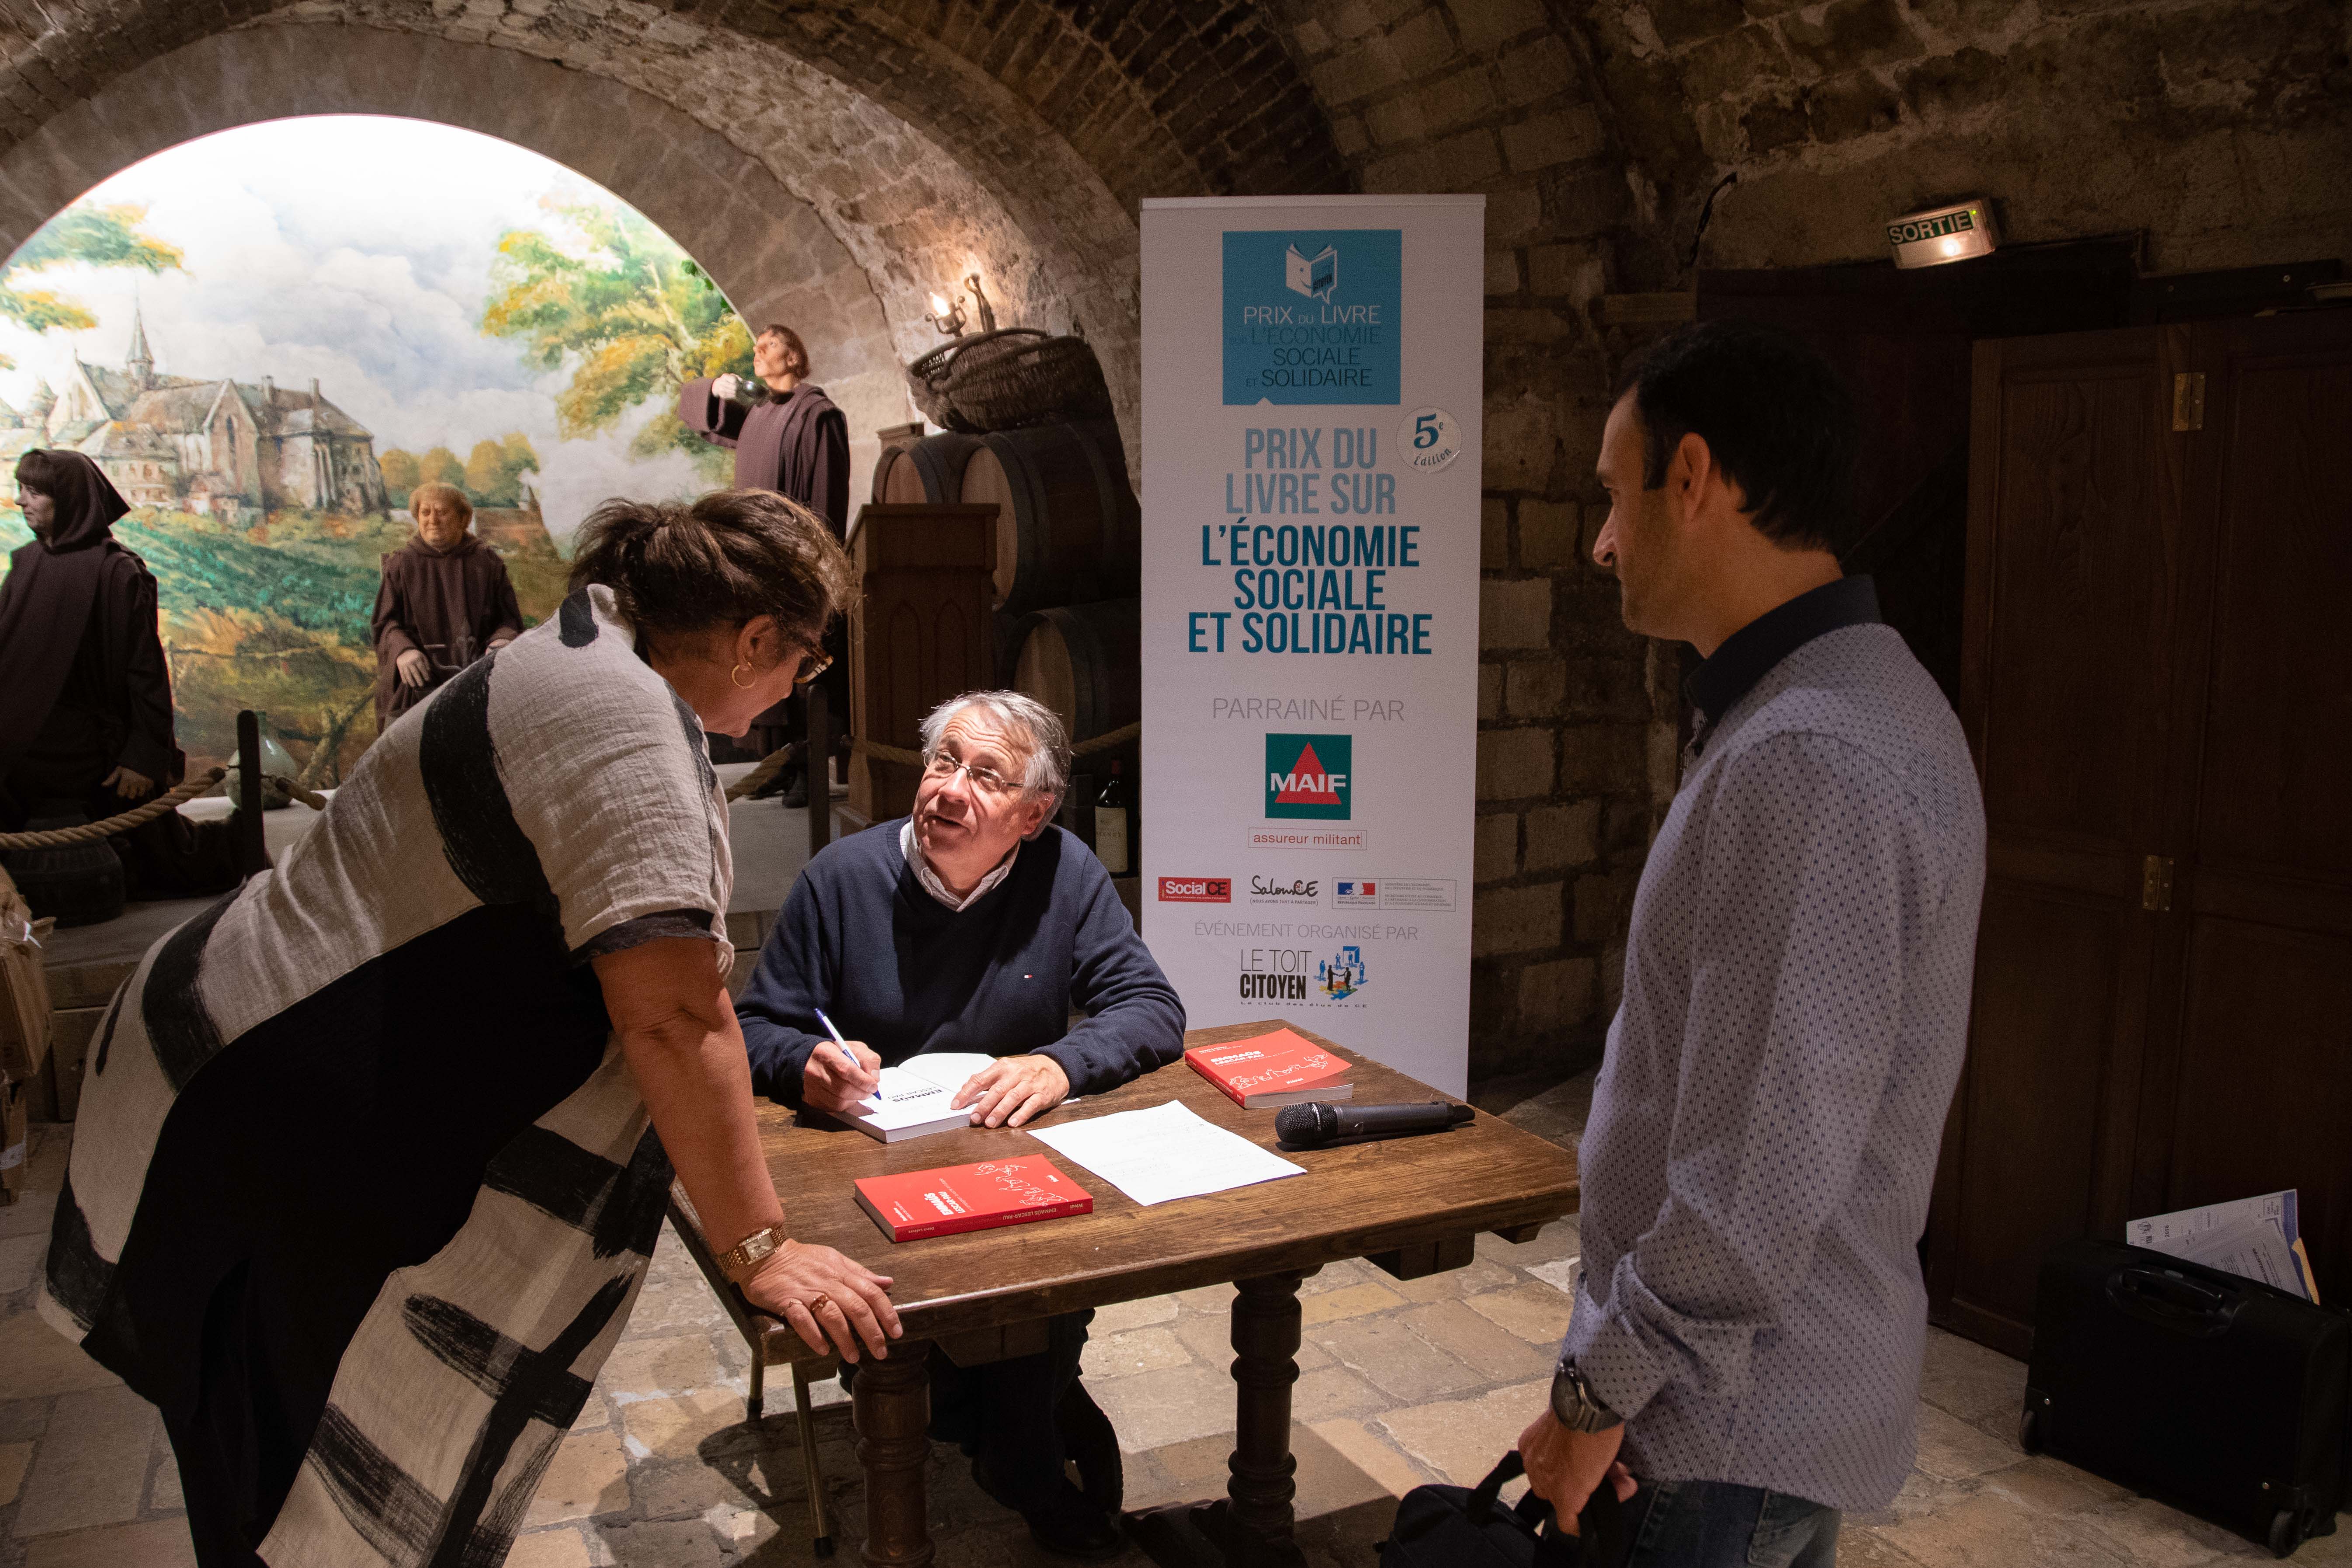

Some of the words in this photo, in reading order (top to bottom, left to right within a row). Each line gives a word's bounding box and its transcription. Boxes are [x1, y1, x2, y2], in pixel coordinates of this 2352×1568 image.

[1888, 212, 1971, 243] SORTIE
[1244, 305, 1293, 324] PRIX
[1298, 315, 1314, 324] DU
[1322, 305, 1381, 324] LIVRE
[1273, 347, 1361, 365] SOCIALE
[1246, 378, 1258, 387] ET
[1262, 368, 1372, 387] SOLIDAIRE
[1245, 428, 1322, 469] PRIX
[1333, 428, 1377, 469] DU
[1226, 473, 1319, 514] LIVRE
[1330, 473, 1395, 514] SUR
[1202, 517, 1420, 567] L'ÉCONOMIE
[1234, 569, 1386, 611] SOCIALE
[1189, 612, 1231, 652] ET
[1242, 613, 1433, 655] SOLIDAIRE
[1213, 694, 1345, 721] PARRAINÉ
[1355, 700, 1405, 721] PAR
[1270, 773, 1346, 792] MAIF
[1253, 834, 1308, 844] assureur
[1313, 834, 1360, 845] militant
[1195, 920, 1293, 937] ÉVÉNEMENT
[1298, 923, 1381, 939] ORGANISÉ
[1386, 926, 1418, 940] PAR
[1241, 949, 1263, 971] LE
[1269, 950, 1312, 972] TOIT
[1240, 974, 1306, 999] CITOYEN
